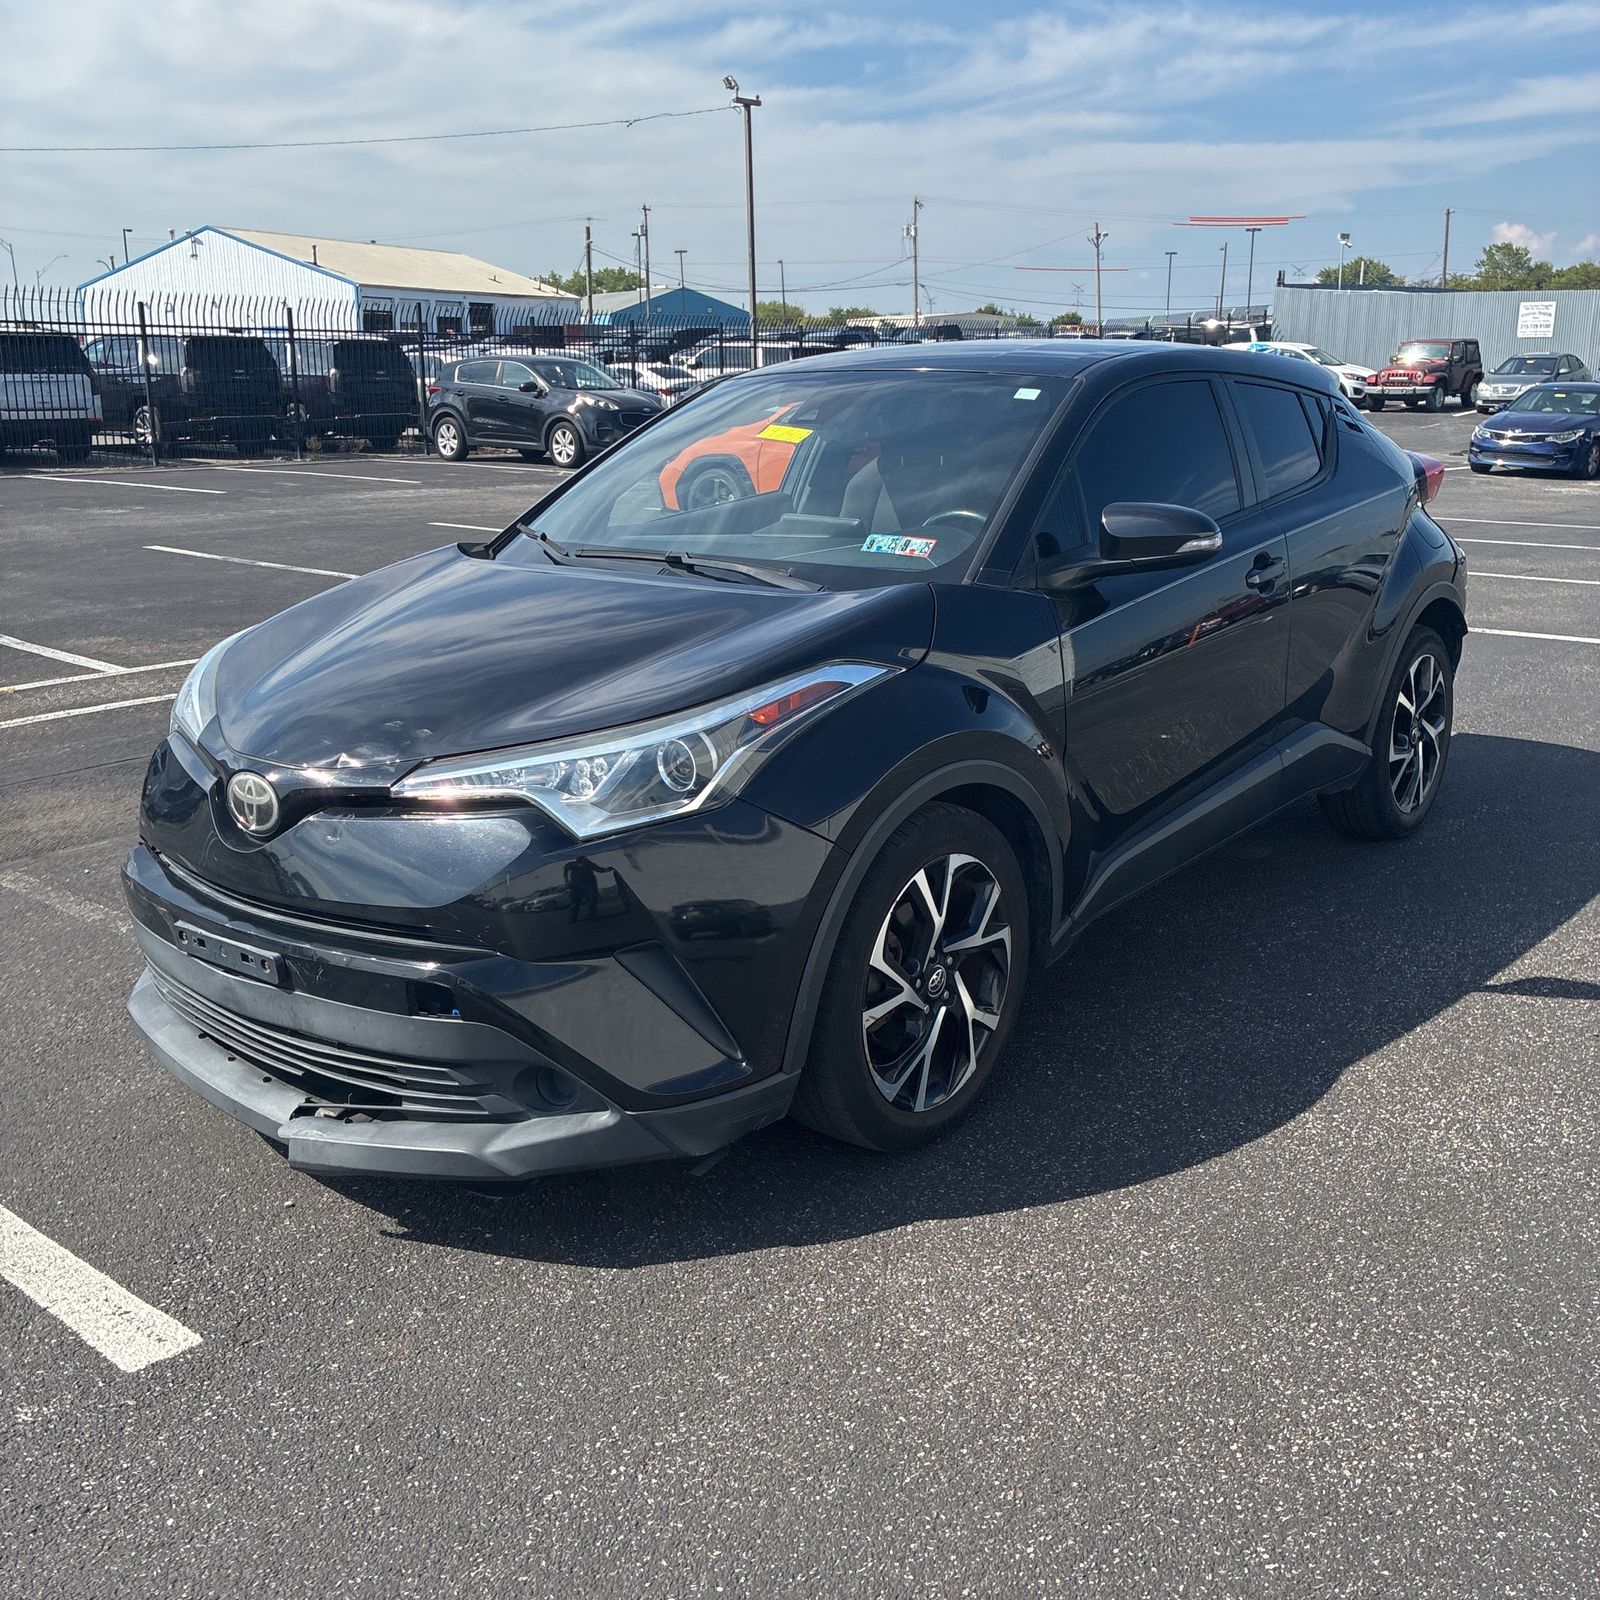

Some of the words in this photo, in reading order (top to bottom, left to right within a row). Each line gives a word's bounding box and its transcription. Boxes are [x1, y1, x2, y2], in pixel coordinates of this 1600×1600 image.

[867, 539, 875, 549] 9
[888, 538, 899, 550] 25
[902, 539, 911, 551] 9
[920, 541, 932, 554] 25
